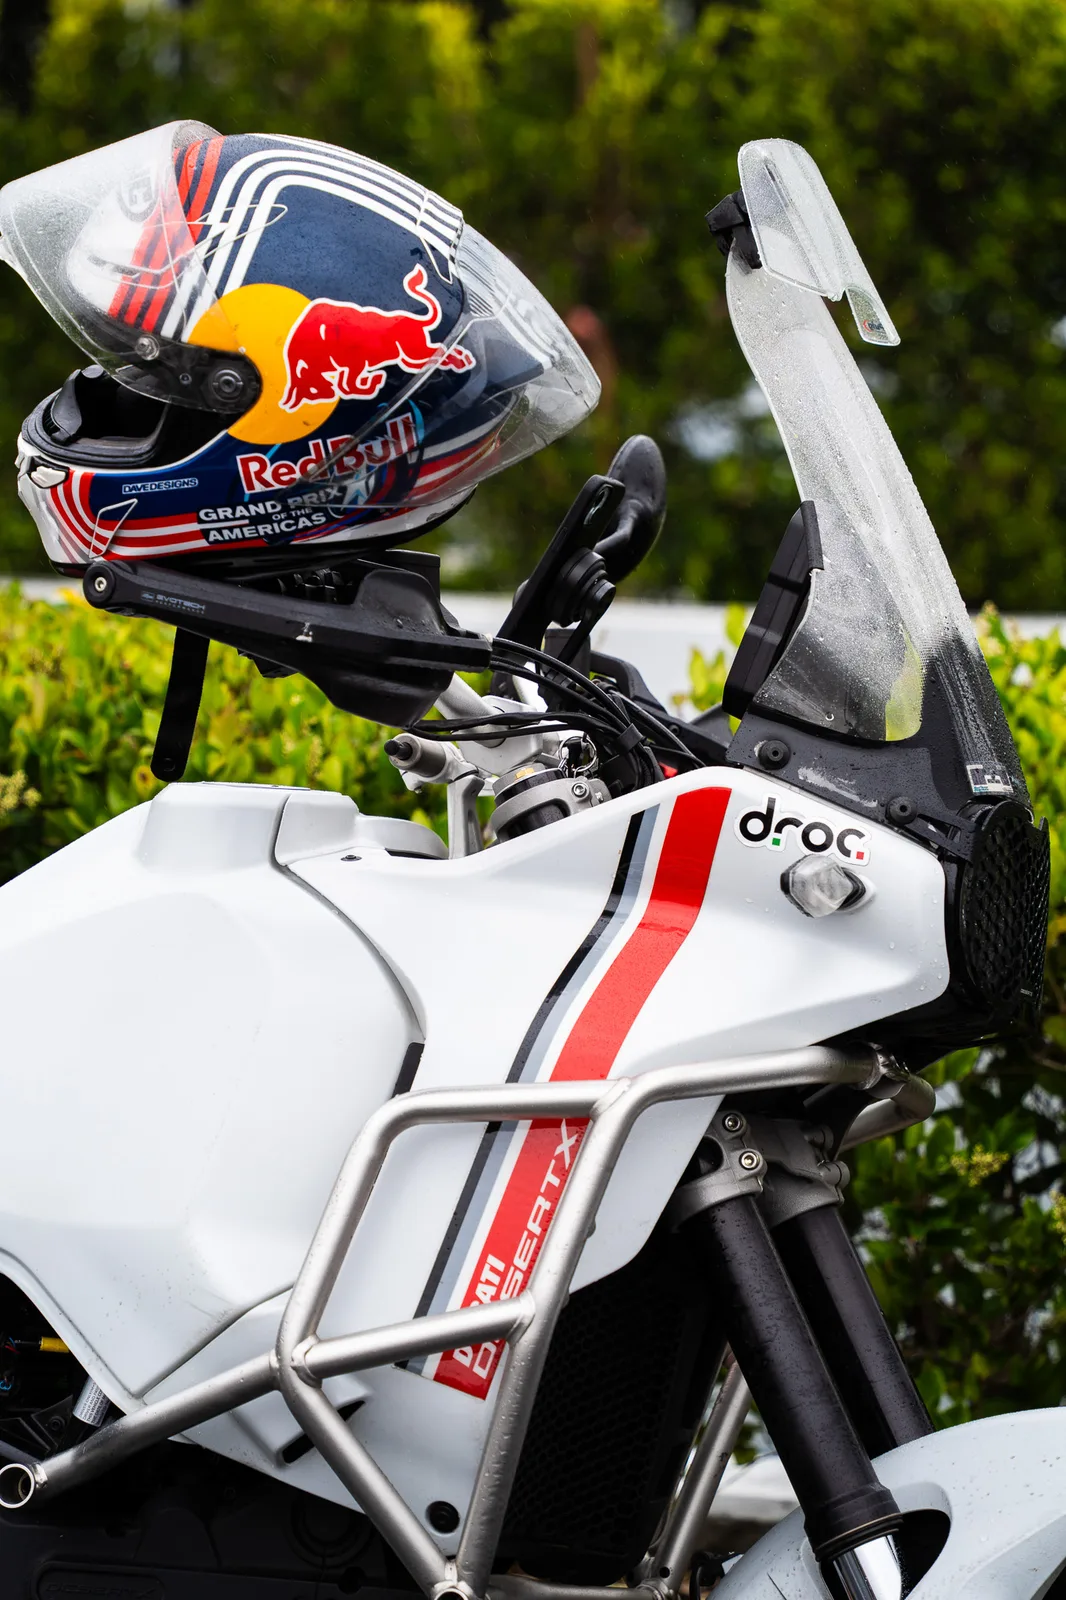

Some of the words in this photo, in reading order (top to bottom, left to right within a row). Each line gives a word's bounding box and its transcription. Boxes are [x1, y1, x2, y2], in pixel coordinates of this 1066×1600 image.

[236, 439, 329, 493] Red
[327, 412, 418, 476] Bull
[199, 500, 282, 521] GRAND
[287, 484, 342, 509] PRIX
[208, 512, 327, 542] AMERICAS
[272, 512, 288, 521] OF
[289, 507, 313, 517] THE
[472, 1119, 579, 1380] DSERTX
[453, 1254, 506, 1368] DATI
